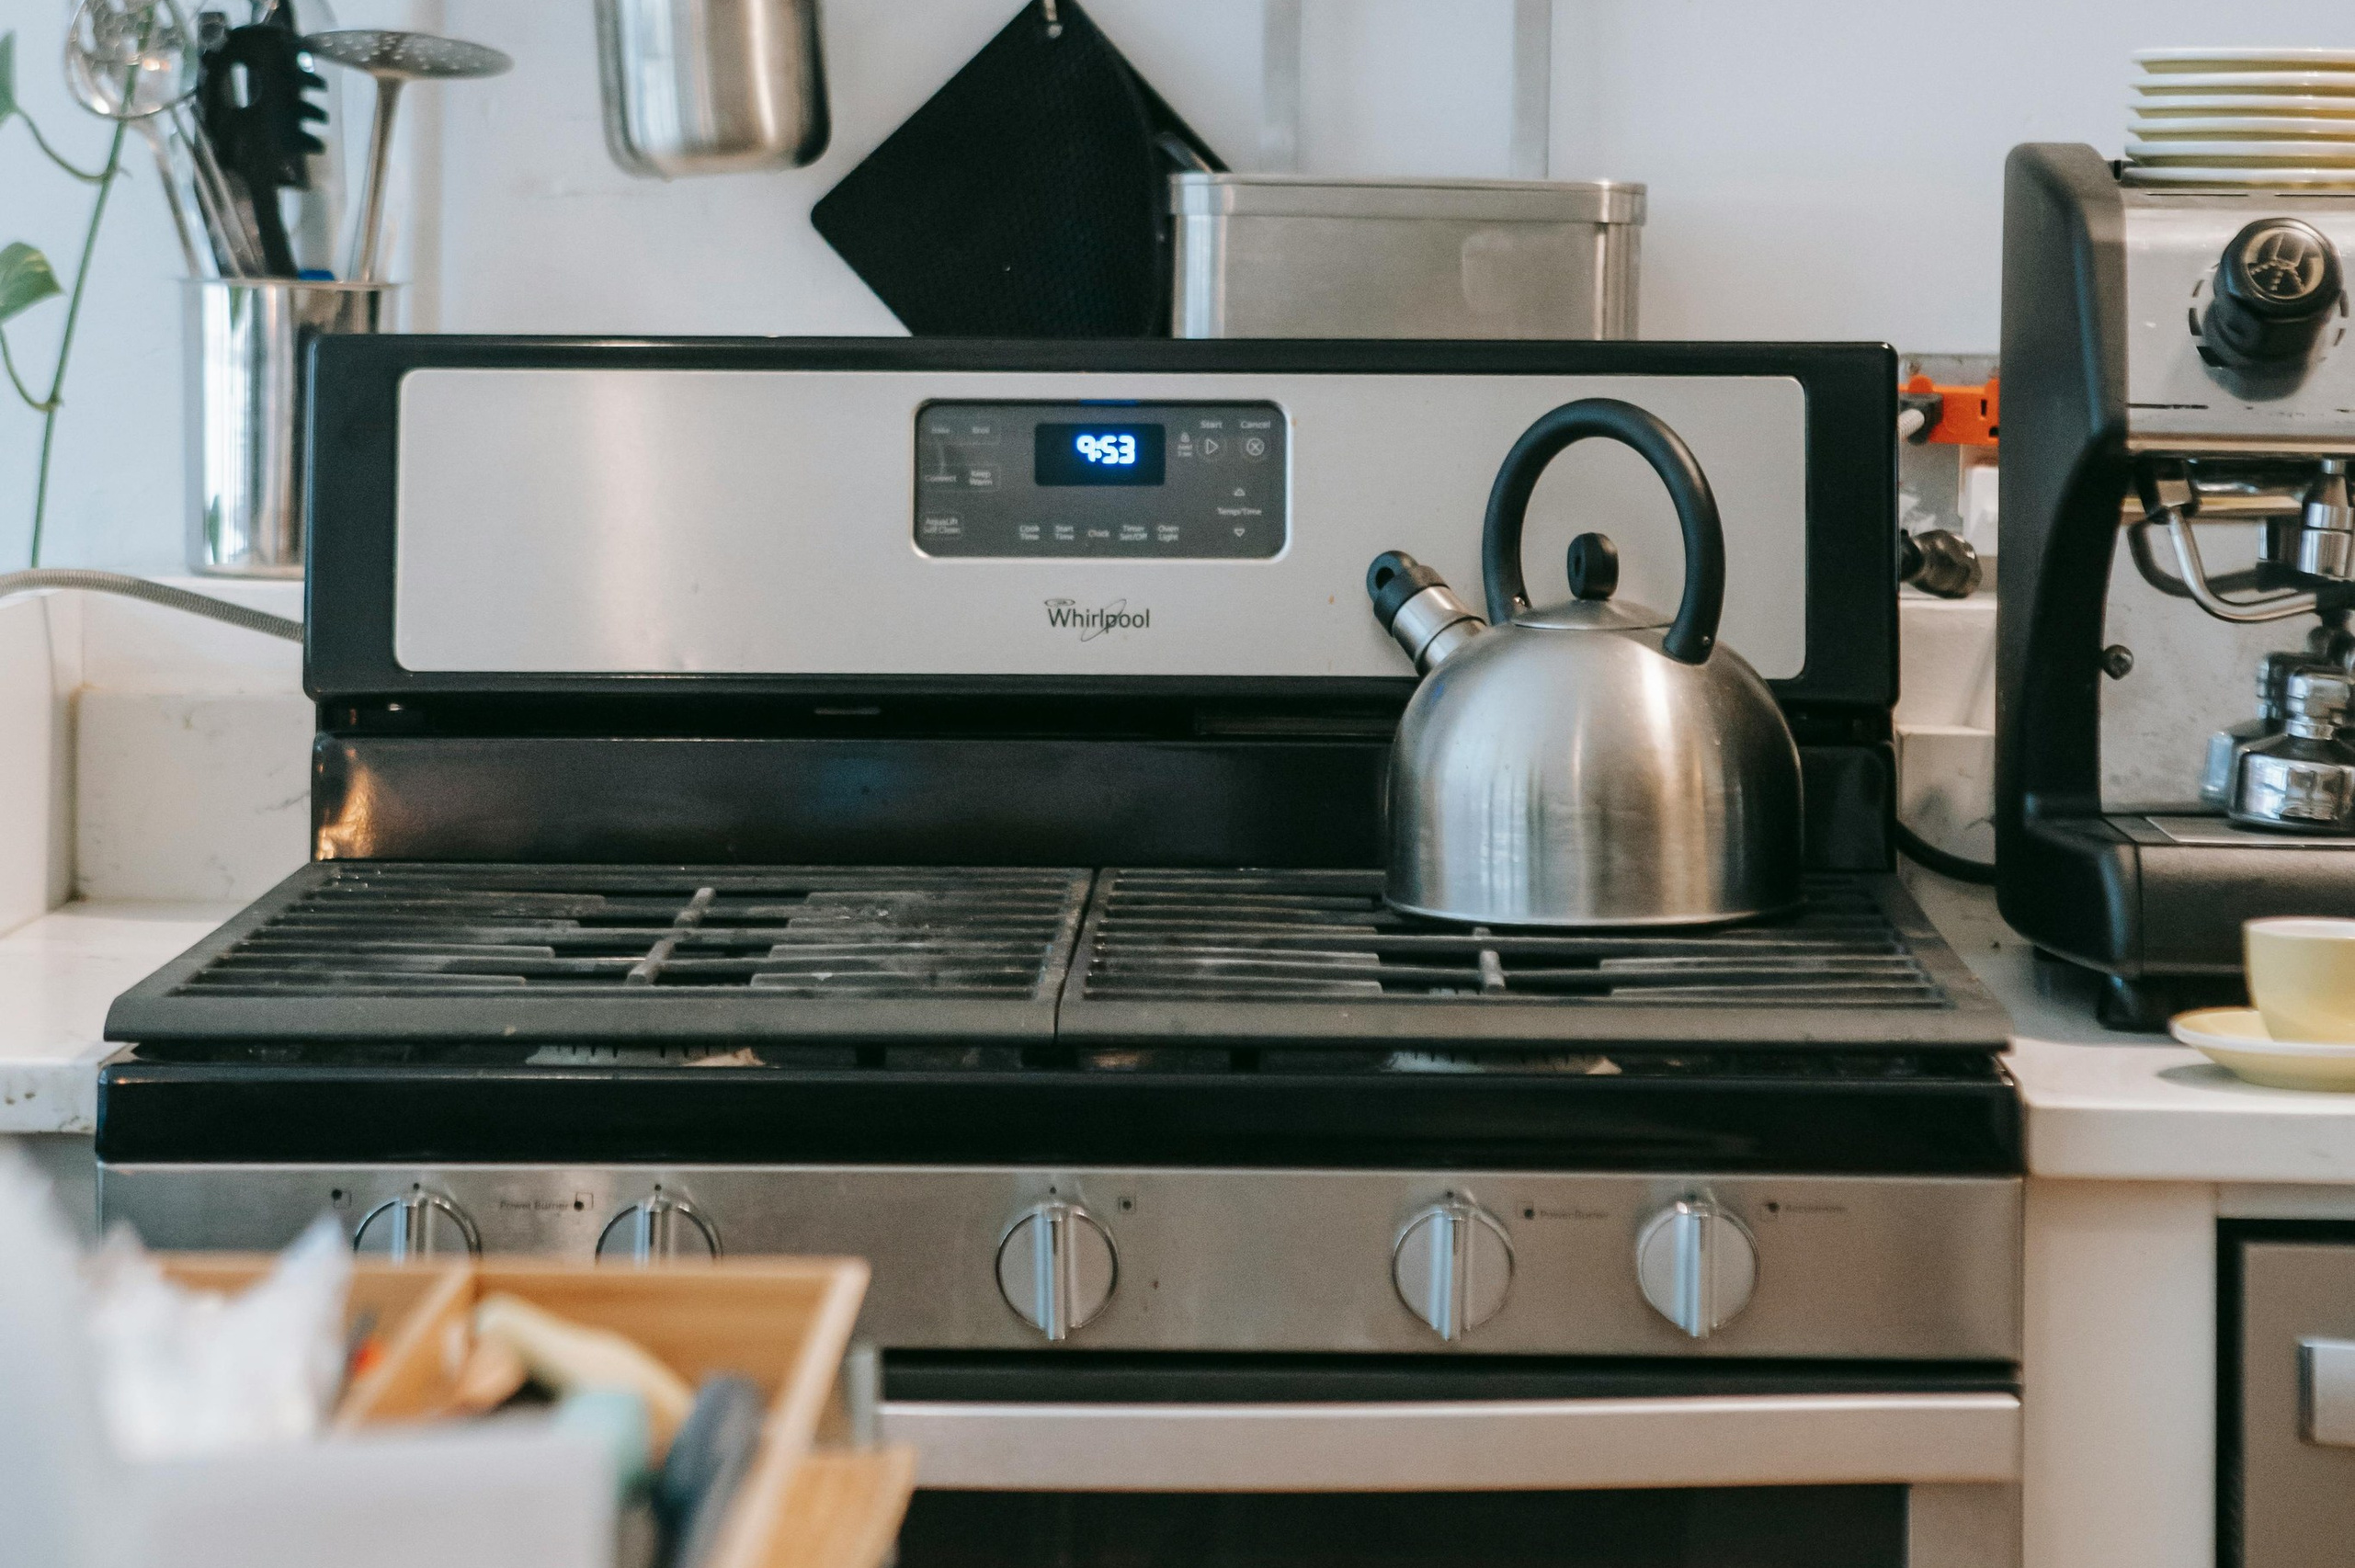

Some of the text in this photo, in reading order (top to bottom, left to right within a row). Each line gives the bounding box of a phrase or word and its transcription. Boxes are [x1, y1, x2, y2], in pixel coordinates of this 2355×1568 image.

[1239, 420, 1271, 429] Cancel
[1075, 435, 1135, 464] 9:53
[1047, 607, 1151, 634] Whirlpool
